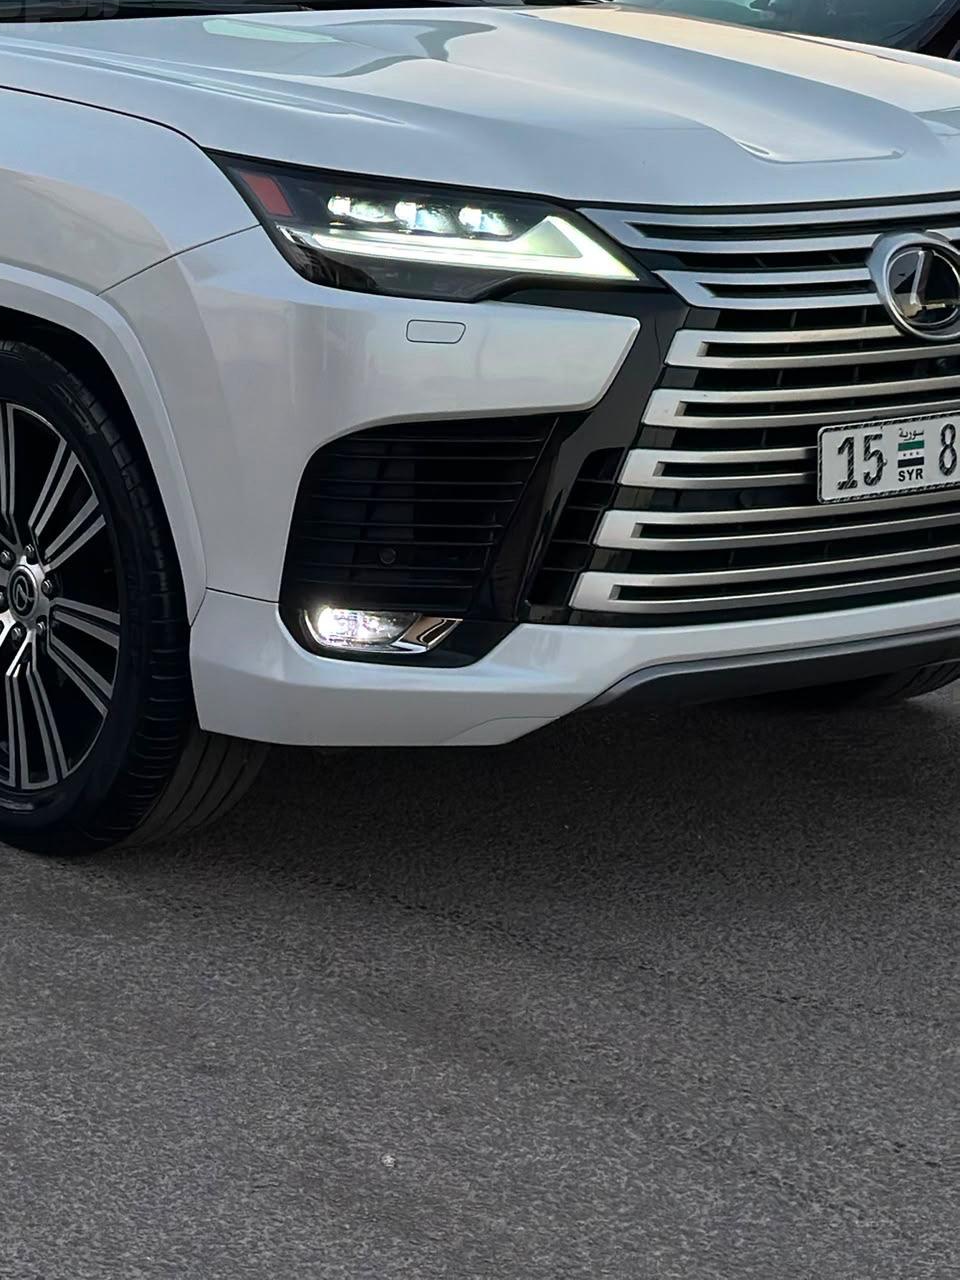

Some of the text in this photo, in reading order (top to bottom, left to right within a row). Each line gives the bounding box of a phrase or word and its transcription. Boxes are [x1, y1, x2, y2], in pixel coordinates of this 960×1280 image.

[898, 428, 925, 441] سورية
[837, 423, 958, 490] 15 8
[898, 468, 924, 482] SYR
